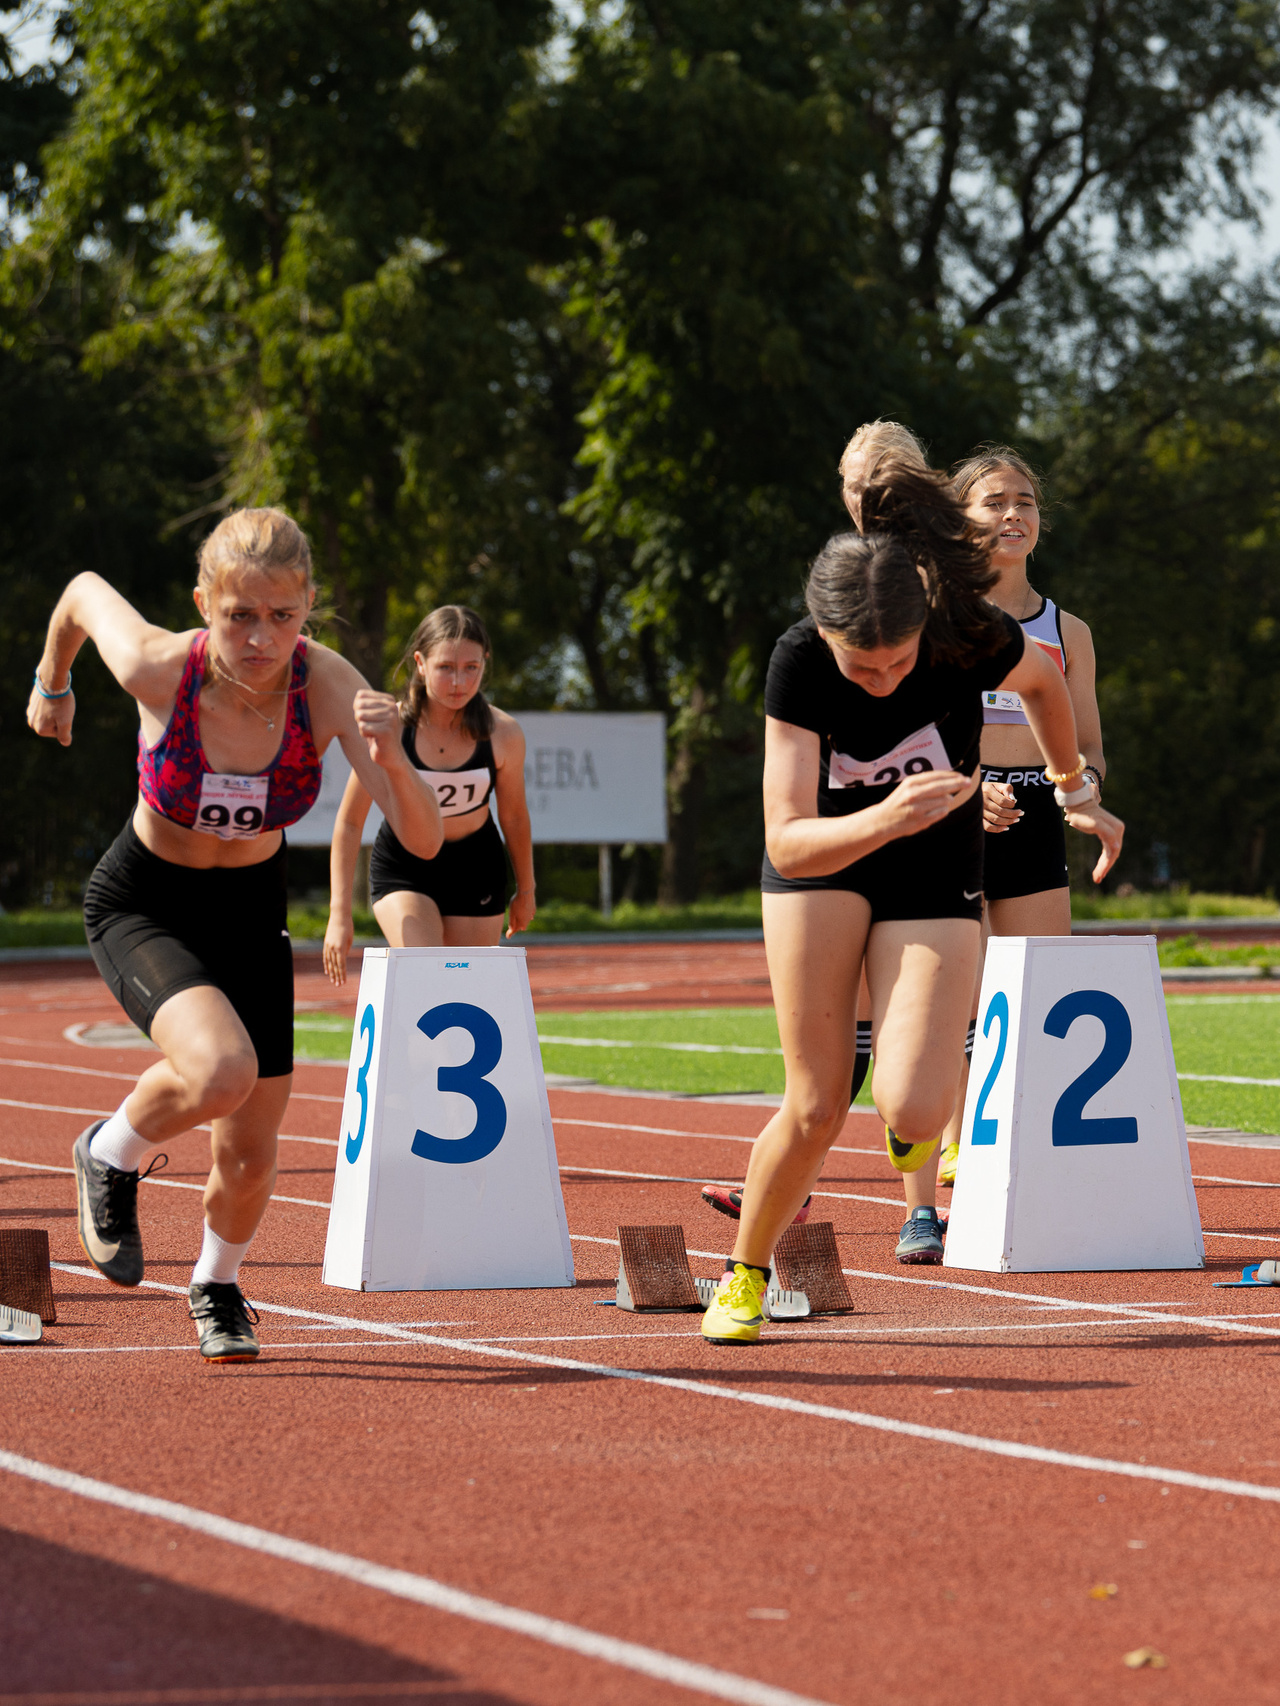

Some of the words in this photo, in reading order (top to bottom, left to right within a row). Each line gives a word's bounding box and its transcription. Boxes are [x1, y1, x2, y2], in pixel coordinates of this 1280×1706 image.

[199, 804, 263, 832] 99
[345, 1003, 375, 1165] 3
[410, 1002, 507, 1164] 3
[971, 991, 1009, 1146] 2
[1043, 989, 1139, 1147] 2
